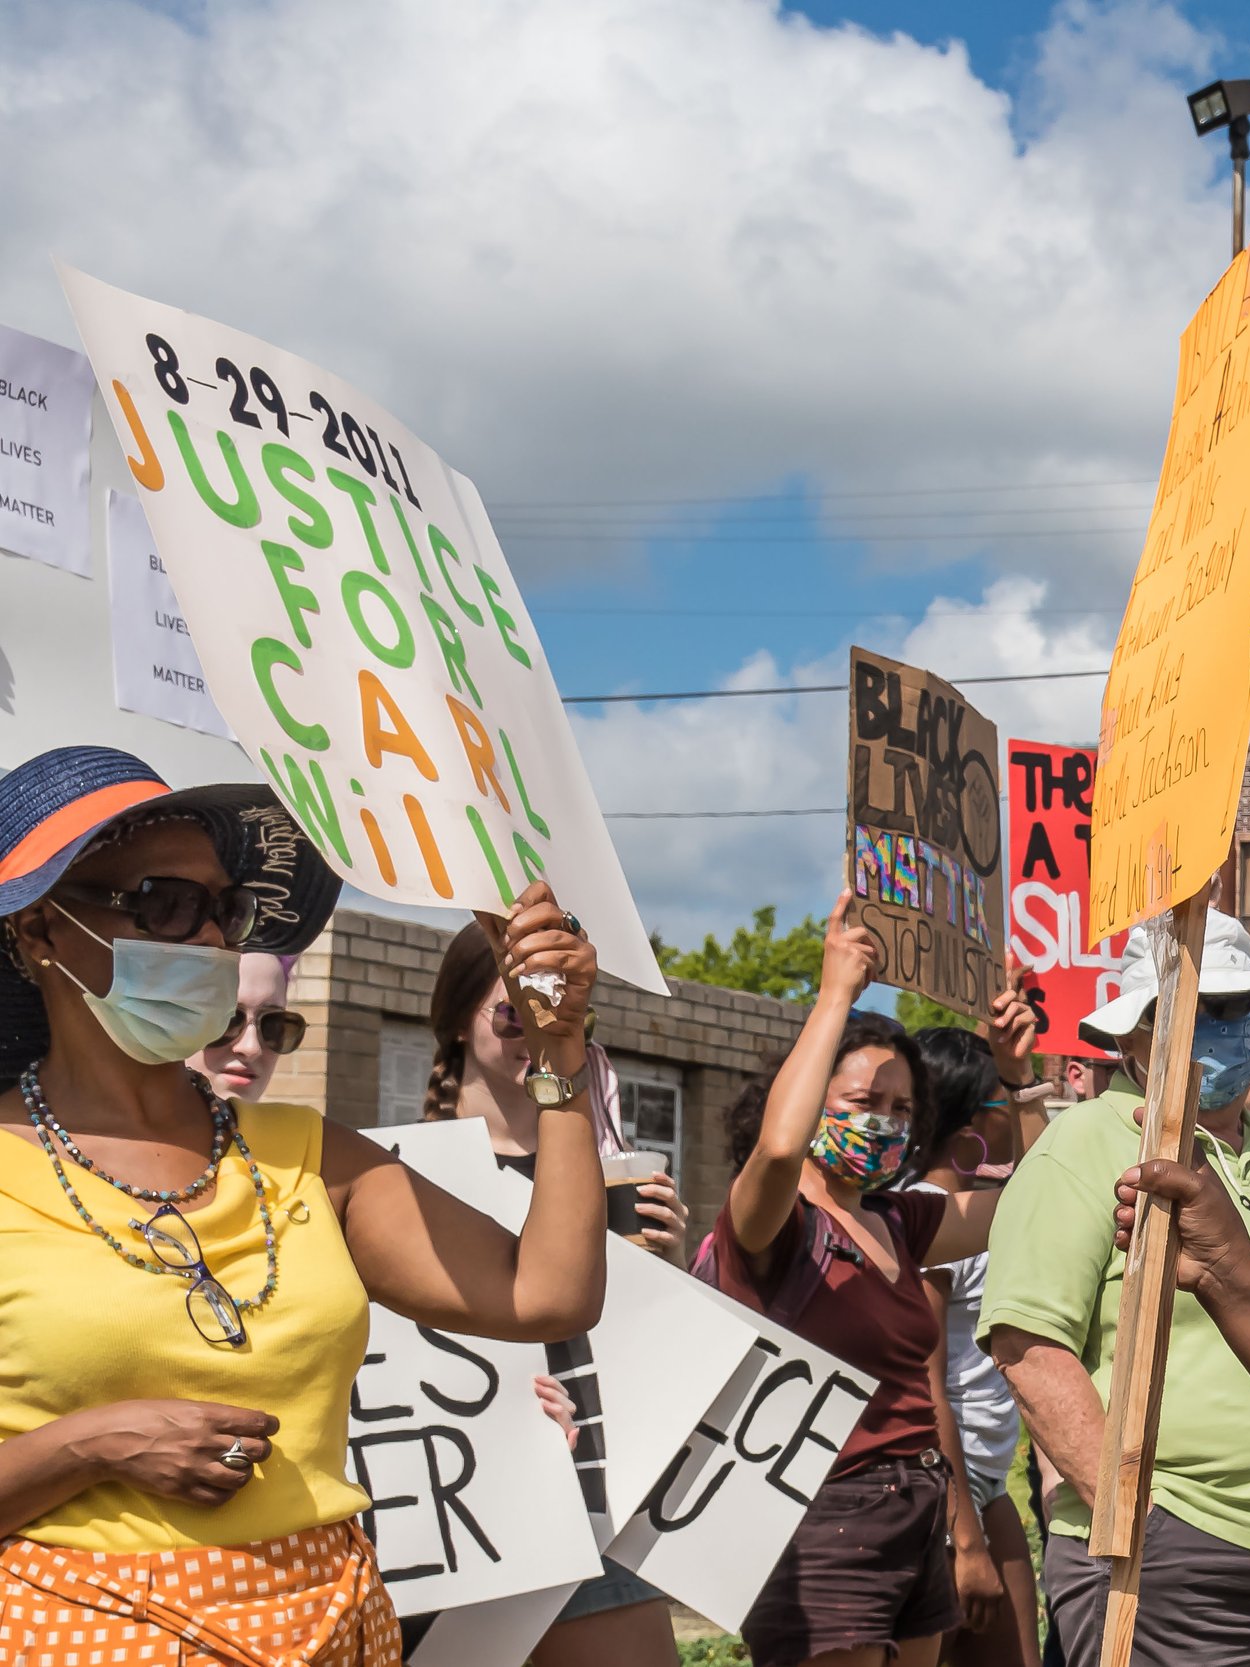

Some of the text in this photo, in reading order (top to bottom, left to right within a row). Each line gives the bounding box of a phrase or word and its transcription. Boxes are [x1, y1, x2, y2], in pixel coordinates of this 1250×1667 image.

[0, 379, 48, 411] BLACK
[146, 333, 422, 511] 8-29-2011
[0, 438, 42, 466] LIVES
[0, 494, 55, 527] MATTER
[112, 379, 531, 670] JUSTICE
[149, 555, 167, 574] BL
[261, 540, 483, 710] FOR
[153, 665, 205, 694] MATTER
[856, 660, 965, 782] BLACK
[251, 637, 550, 840] CARL
[1132, 709, 1209, 808] Jackson
[854, 745, 963, 850] LIVES
[855, 824, 992, 950] MATTER
[1022, 822, 1060, 880] A
[1127, 822, 1182, 918] Wright
[861, 904, 932, 987] STOP
